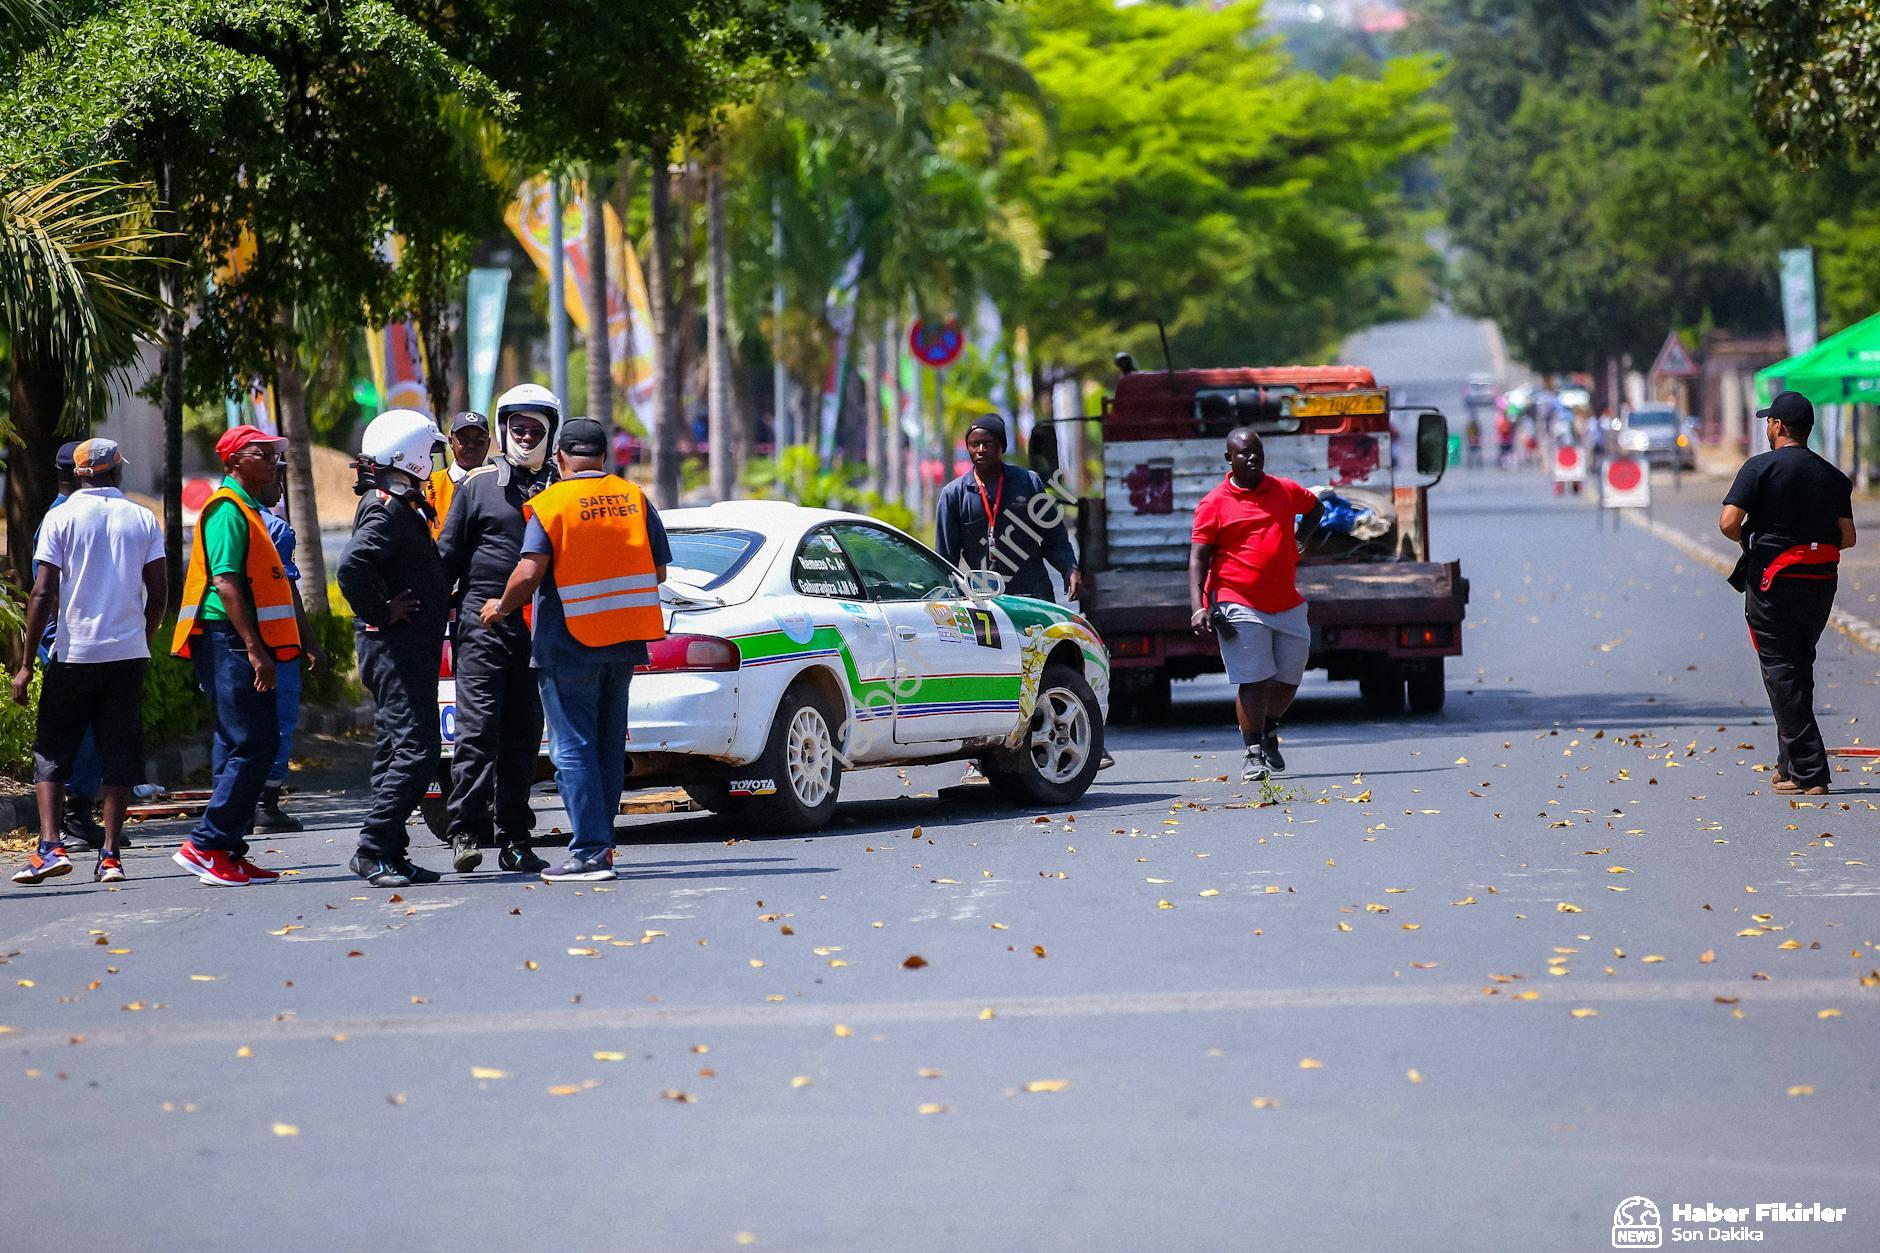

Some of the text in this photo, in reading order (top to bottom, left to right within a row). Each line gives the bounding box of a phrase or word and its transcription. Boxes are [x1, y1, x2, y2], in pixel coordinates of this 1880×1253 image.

[580, 493, 630, 508] SAFETY
[580, 504, 639, 521] OFFICER
[976, 612, 992, 646] 7
[730, 778, 776, 790] TOYOTA
